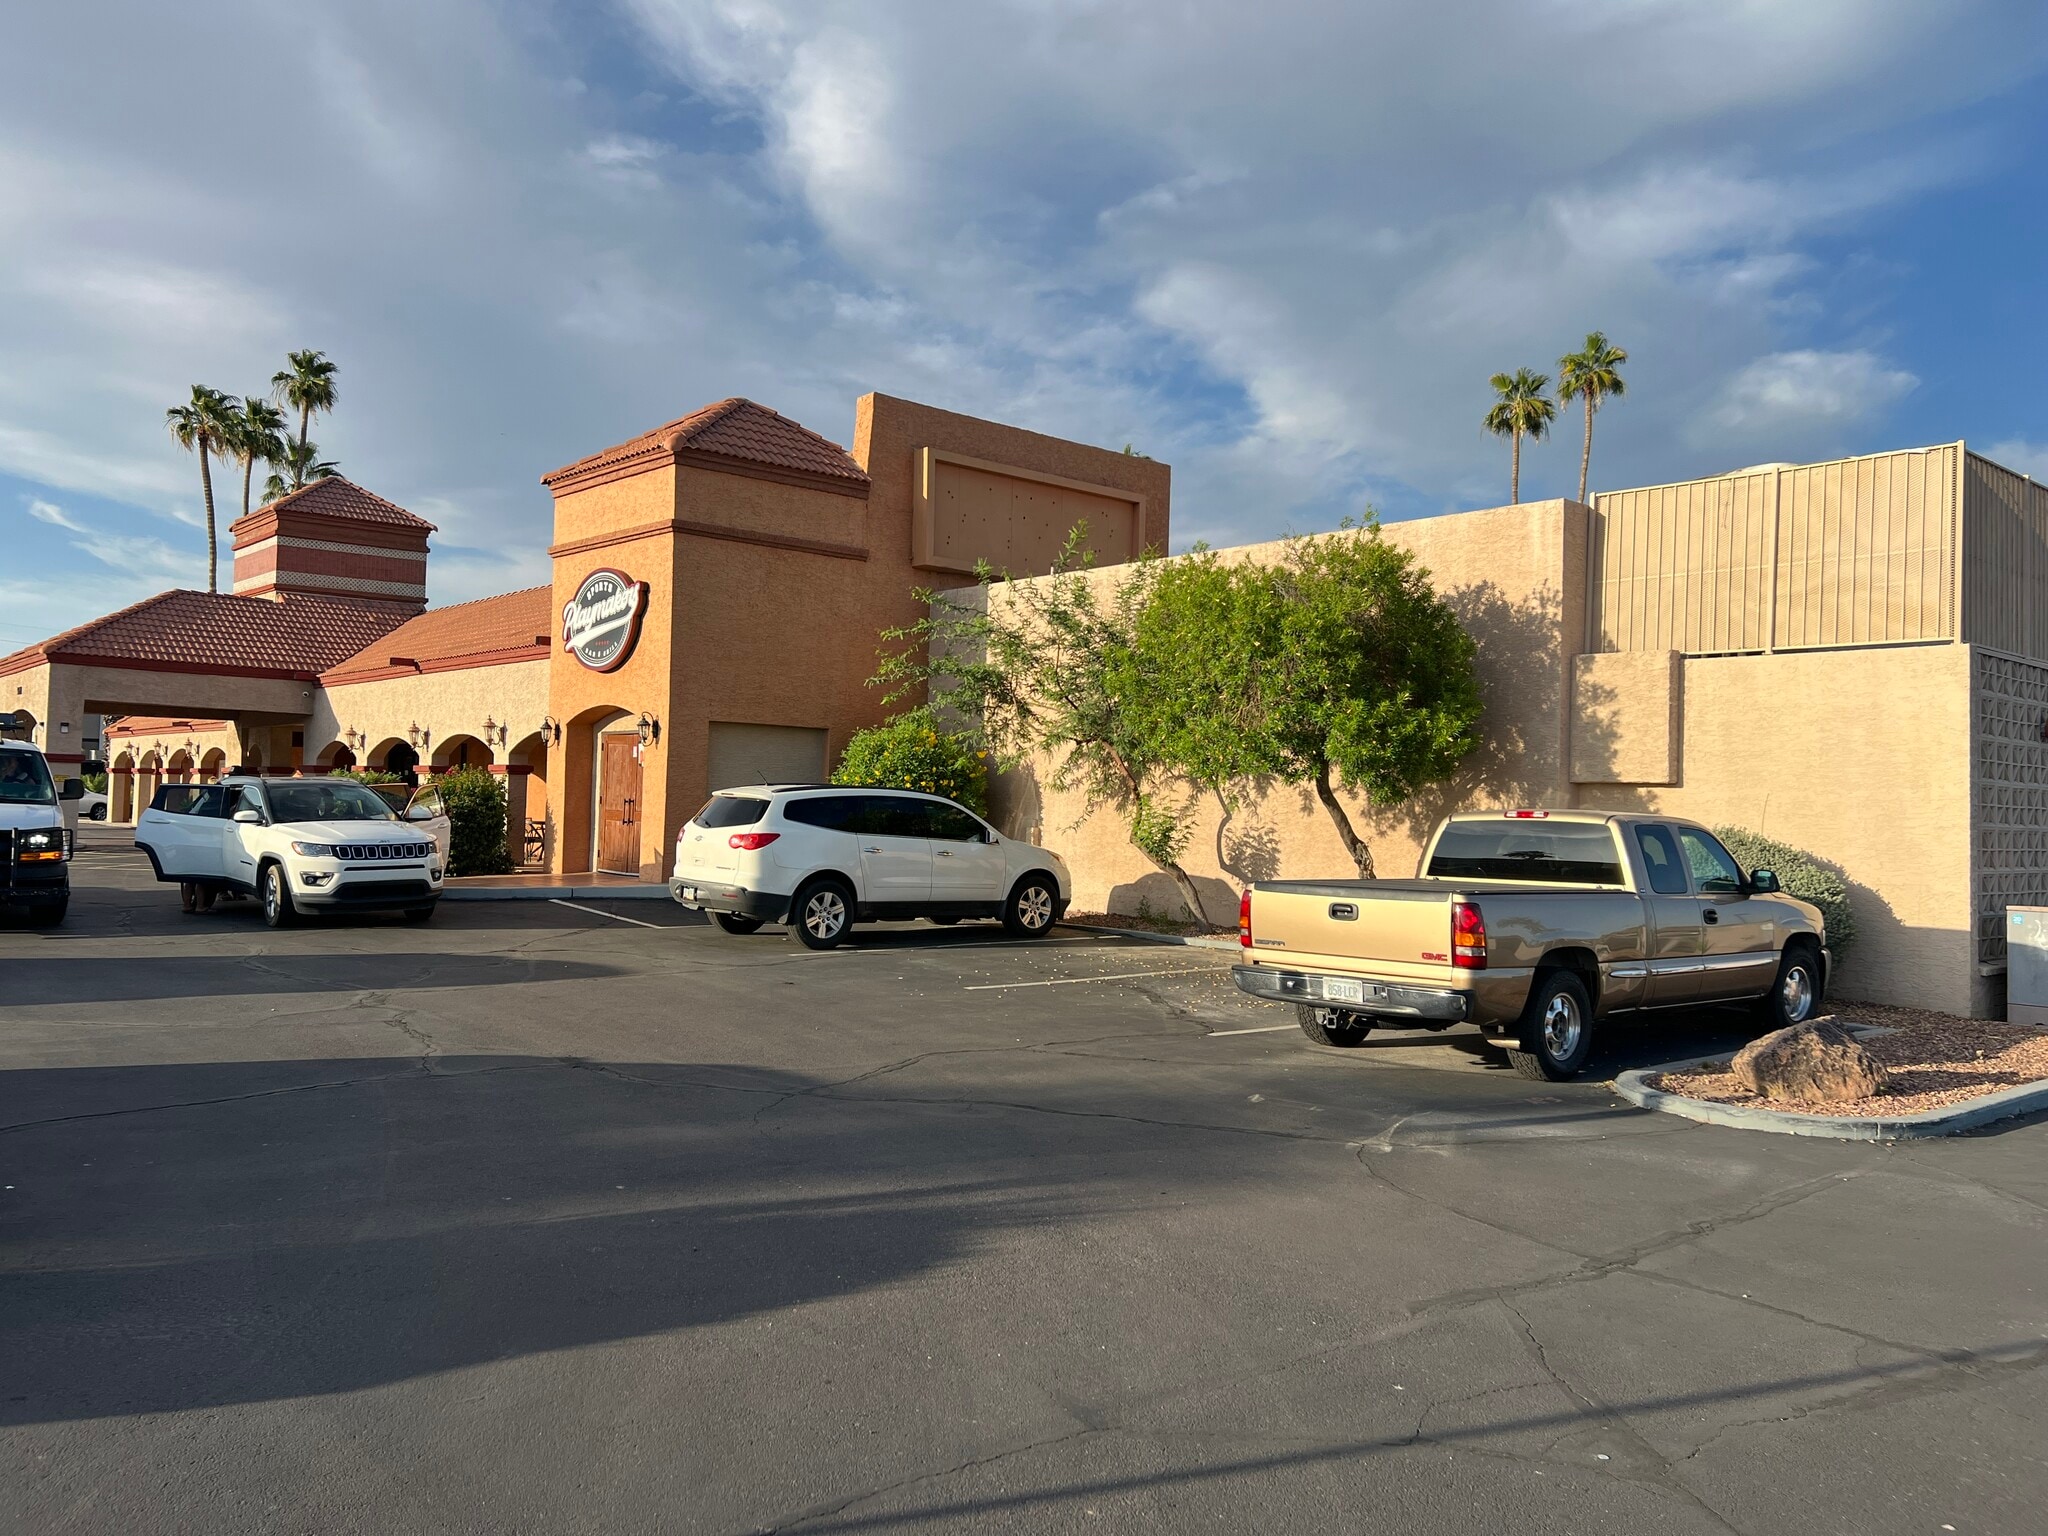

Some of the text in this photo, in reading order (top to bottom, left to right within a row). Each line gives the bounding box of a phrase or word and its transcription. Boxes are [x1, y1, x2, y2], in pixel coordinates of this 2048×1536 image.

[586, 582, 613, 600] SPORTS
[563, 583, 640, 641] Playmakers
[585, 647, 596, 658] BAR
[1421, 952, 1448, 962] GMC
